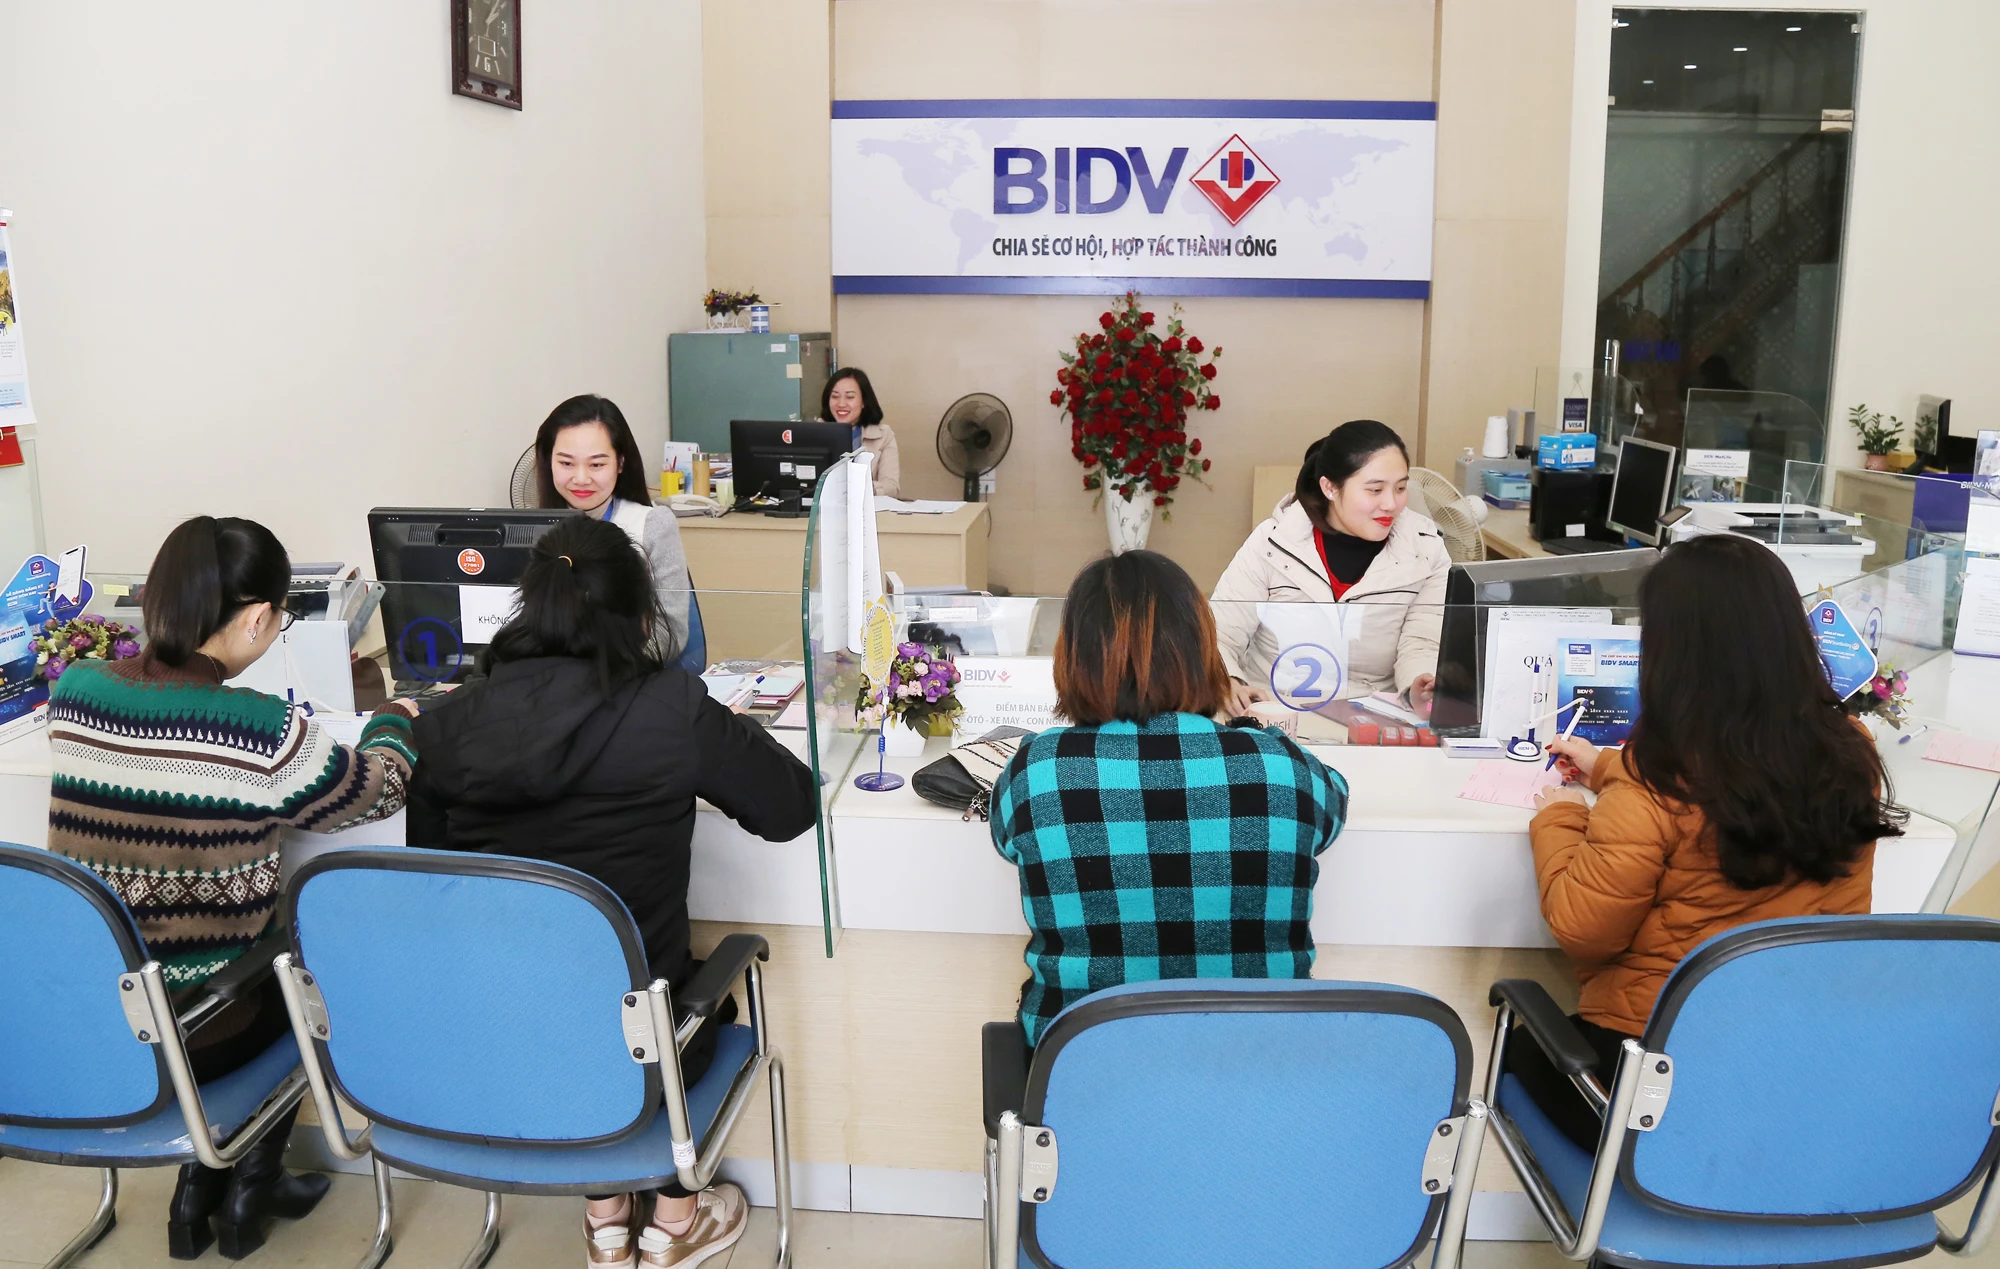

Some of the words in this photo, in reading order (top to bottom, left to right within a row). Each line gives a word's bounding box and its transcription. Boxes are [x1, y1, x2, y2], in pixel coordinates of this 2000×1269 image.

[993, 147, 1189, 214] BIDV
[992, 237, 1028, 256] CHIA
[1032, 234, 1049, 256] SẺ
[1052, 236, 1073, 256] CƠ
[1076, 234, 1108, 260] HỘI,
[1112, 236, 1144, 260] HỢP
[1148, 235, 1175, 256] TÁC
[1177, 235, 1231, 257] THÀNH
[1235, 235, 1277, 257] CÔNG
[1870, 619, 1877, 649] 3
[418, 631, 438, 669] 1
[964, 669, 996, 681] BIDV
[1291, 657, 1322, 697] 2
[991, 717, 1001, 725] XE
[1003, 716, 1020, 725] MÁY
[1027, 717, 1044, 725] CON
[996, 702, 1017, 712] ĐIỂM
[1019, 703, 1036, 712] BÁN
